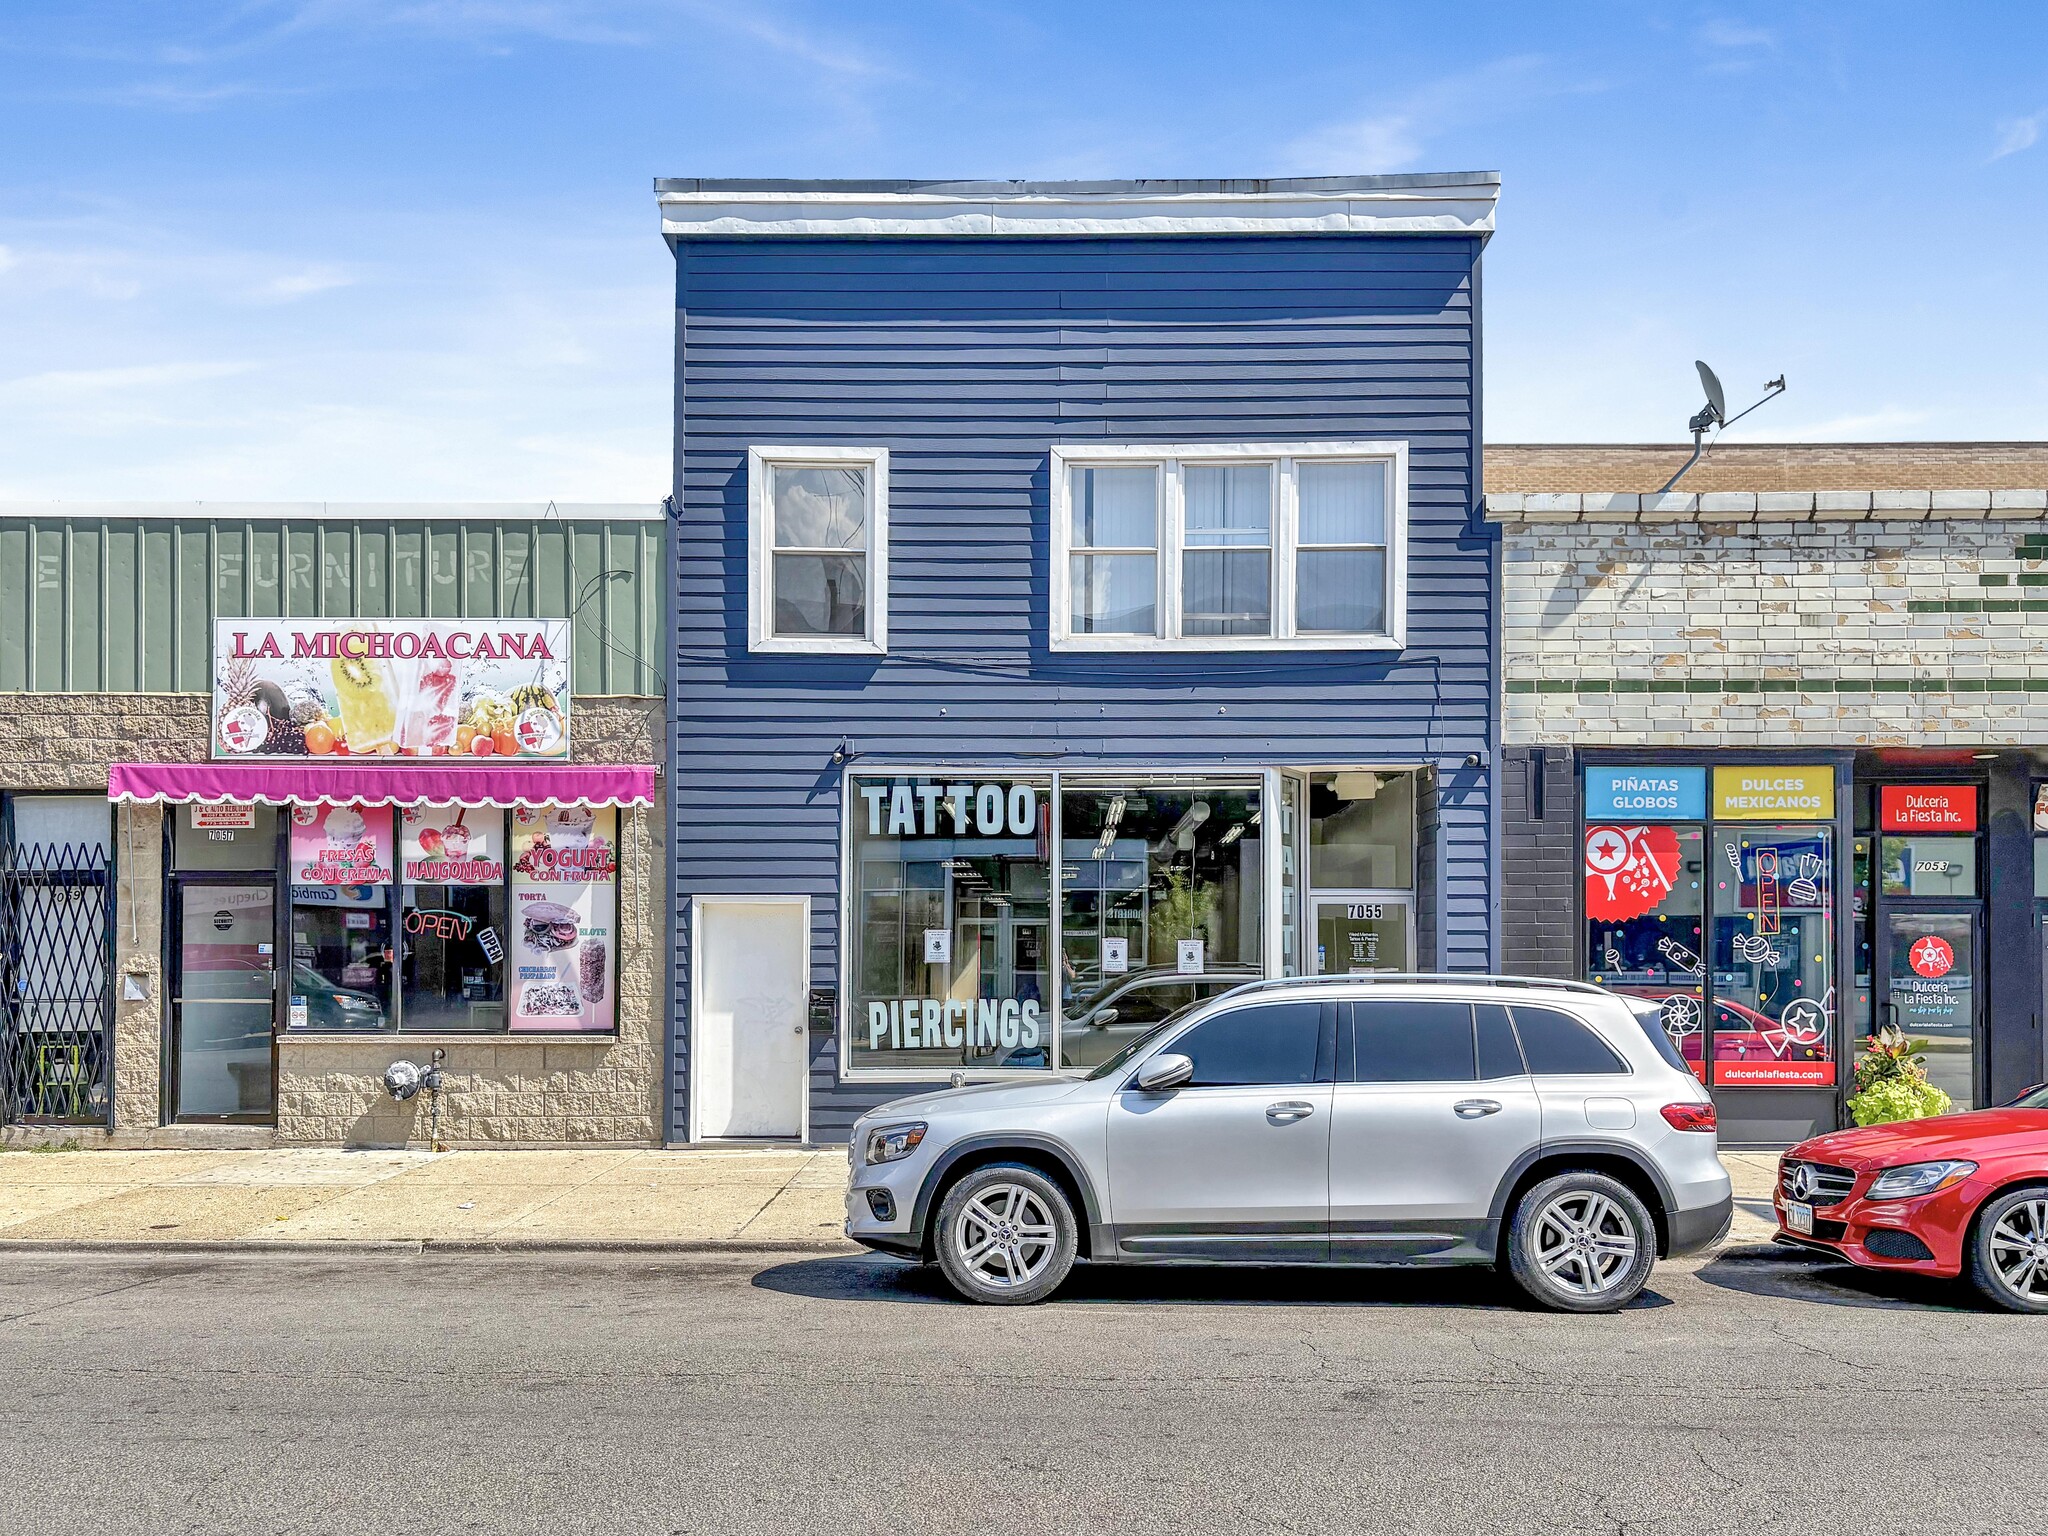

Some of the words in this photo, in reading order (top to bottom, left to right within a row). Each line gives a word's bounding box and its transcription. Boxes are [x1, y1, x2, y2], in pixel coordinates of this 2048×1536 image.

[219, 550, 529, 588] FURNITURE
[232, 632, 284, 659] LA
[291, 632, 554, 659] MICHOACANA
[1612, 776, 1679, 792] PIÑATAS
[1742, 779, 1804, 791] DULCES
[1612, 796, 1678, 809] GLOBOS
[1725, 796, 1821, 808] MEXICANOS
[1906, 795, 1949, 808] Dulceria
[860, 784, 1036, 835] TATTOO
[1896, 809, 1908, 822] La
[1910, 809, 1942, 822] Fiesta
[1944, 809, 1962, 822] Inc.
[209, 830, 234, 840] 7057
[318, 849, 374, 862] FRESAS
[530, 848, 610, 868] YOGURT
[406, 861, 504, 881] MANGONADA
[1916, 862, 1948, 871] 7053
[301, 868, 336, 881] CON
[336, 868, 392, 881] CREMA
[530, 870, 560, 882] CON
[564, 870, 611, 882] FRUTA
[1759, 852, 1777, 932] OPEN
[1348, 904, 1382, 918] 7055
[406, 912, 468, 941] OPEN
[480, 930, 503, 961] OPEN
[1912, 981, 1948, 993] Dulceria
[1904, 993, 1914, 1004] La
[1916, 993, 1944, 1004] Fiesta
[1944, 993, 1959, 1004] Inc.
[1928, 1006, 1942, 1016] party
[868, 998, 1040, 1050] PIERCINGS
[1725, 1070, 1823, 1079] dulcerialafiesta.com
